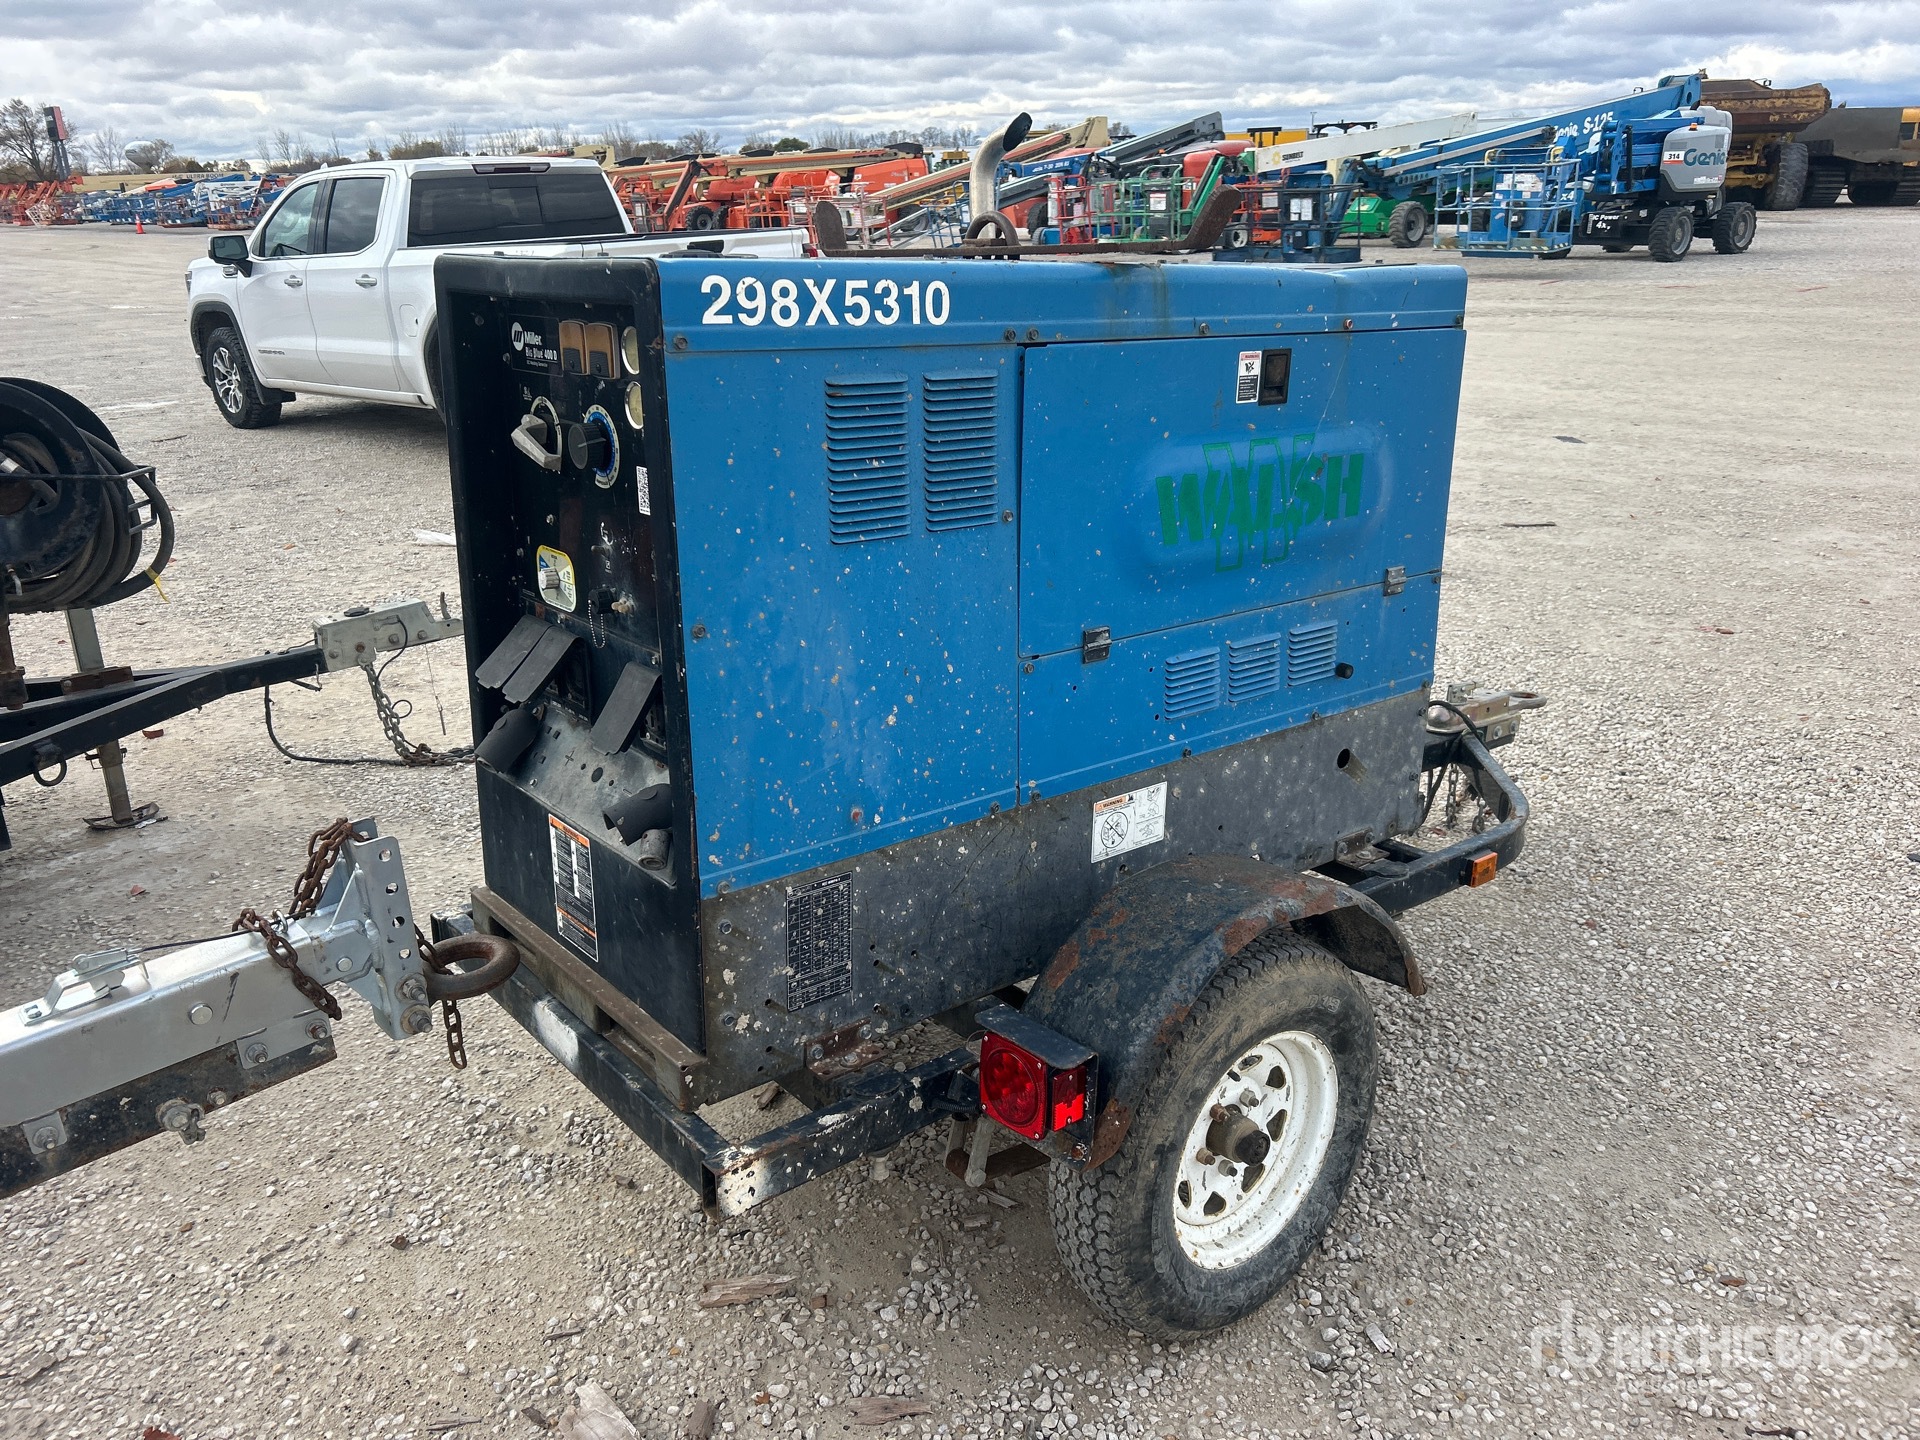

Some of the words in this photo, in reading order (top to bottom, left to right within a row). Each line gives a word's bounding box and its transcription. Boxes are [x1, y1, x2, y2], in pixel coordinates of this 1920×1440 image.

[1684, 148, 1726, 167] Genie
[700, 274, 951, 327] 298X5310
[524, 331, 543, 346] Miller
[525, 346, 533, 358] Big
[533, 347, 543, 359] Blue
[544, 349, 553, 360] 400
[1155, 450, 1364, 550] WALSH
